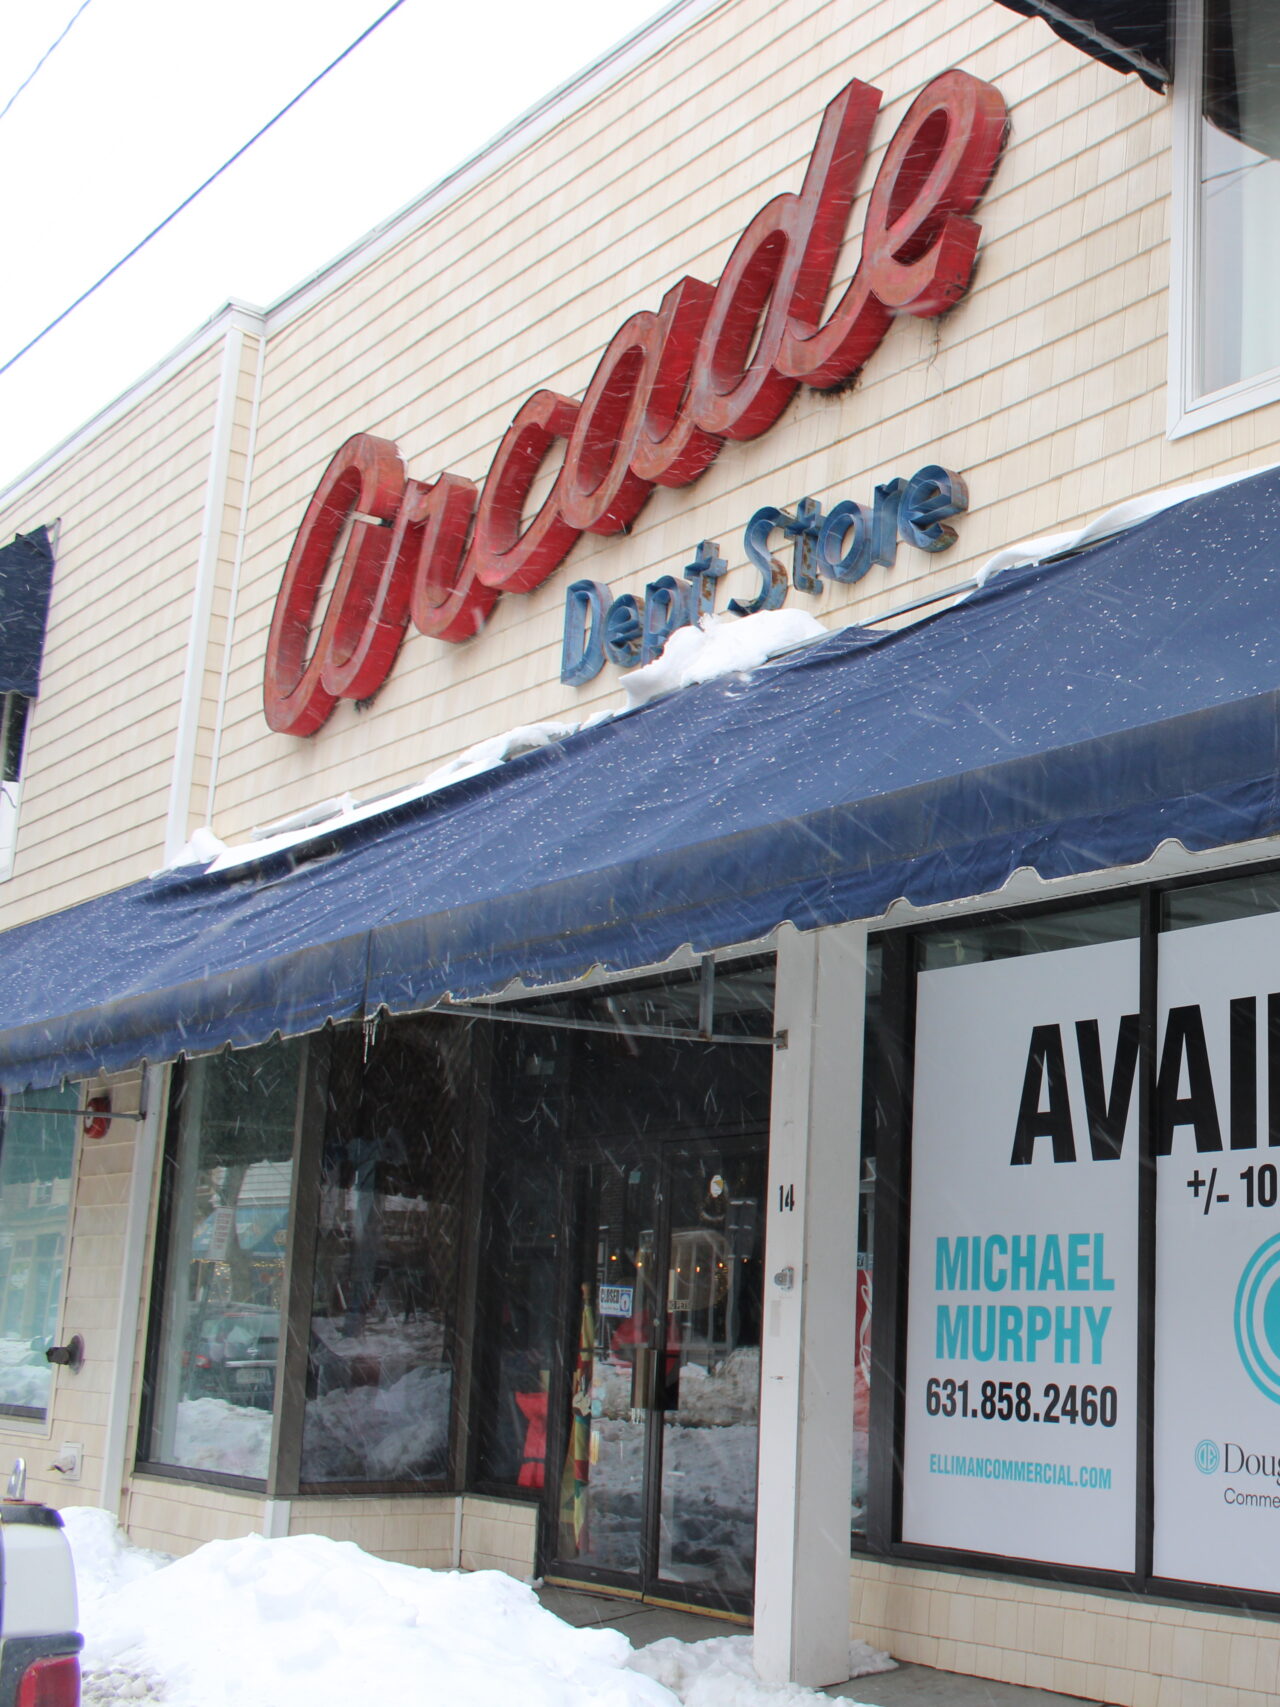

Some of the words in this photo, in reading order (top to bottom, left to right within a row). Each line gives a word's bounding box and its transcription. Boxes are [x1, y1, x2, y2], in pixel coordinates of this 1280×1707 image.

[263, 68, 1010, 738] Arcade
[727, 464, 969, 616] Store
[779, 1183, 795, 1212] 14
[935, 1233, 1115, 1292] MICHAEL
[935, 1305, 1113, 1365] MURPHY
[926, 1377, 1118, 1428] 631.858.2460
[929, 1453, 1112, 1490] ELLIMANCOMMERCIAL.COM
